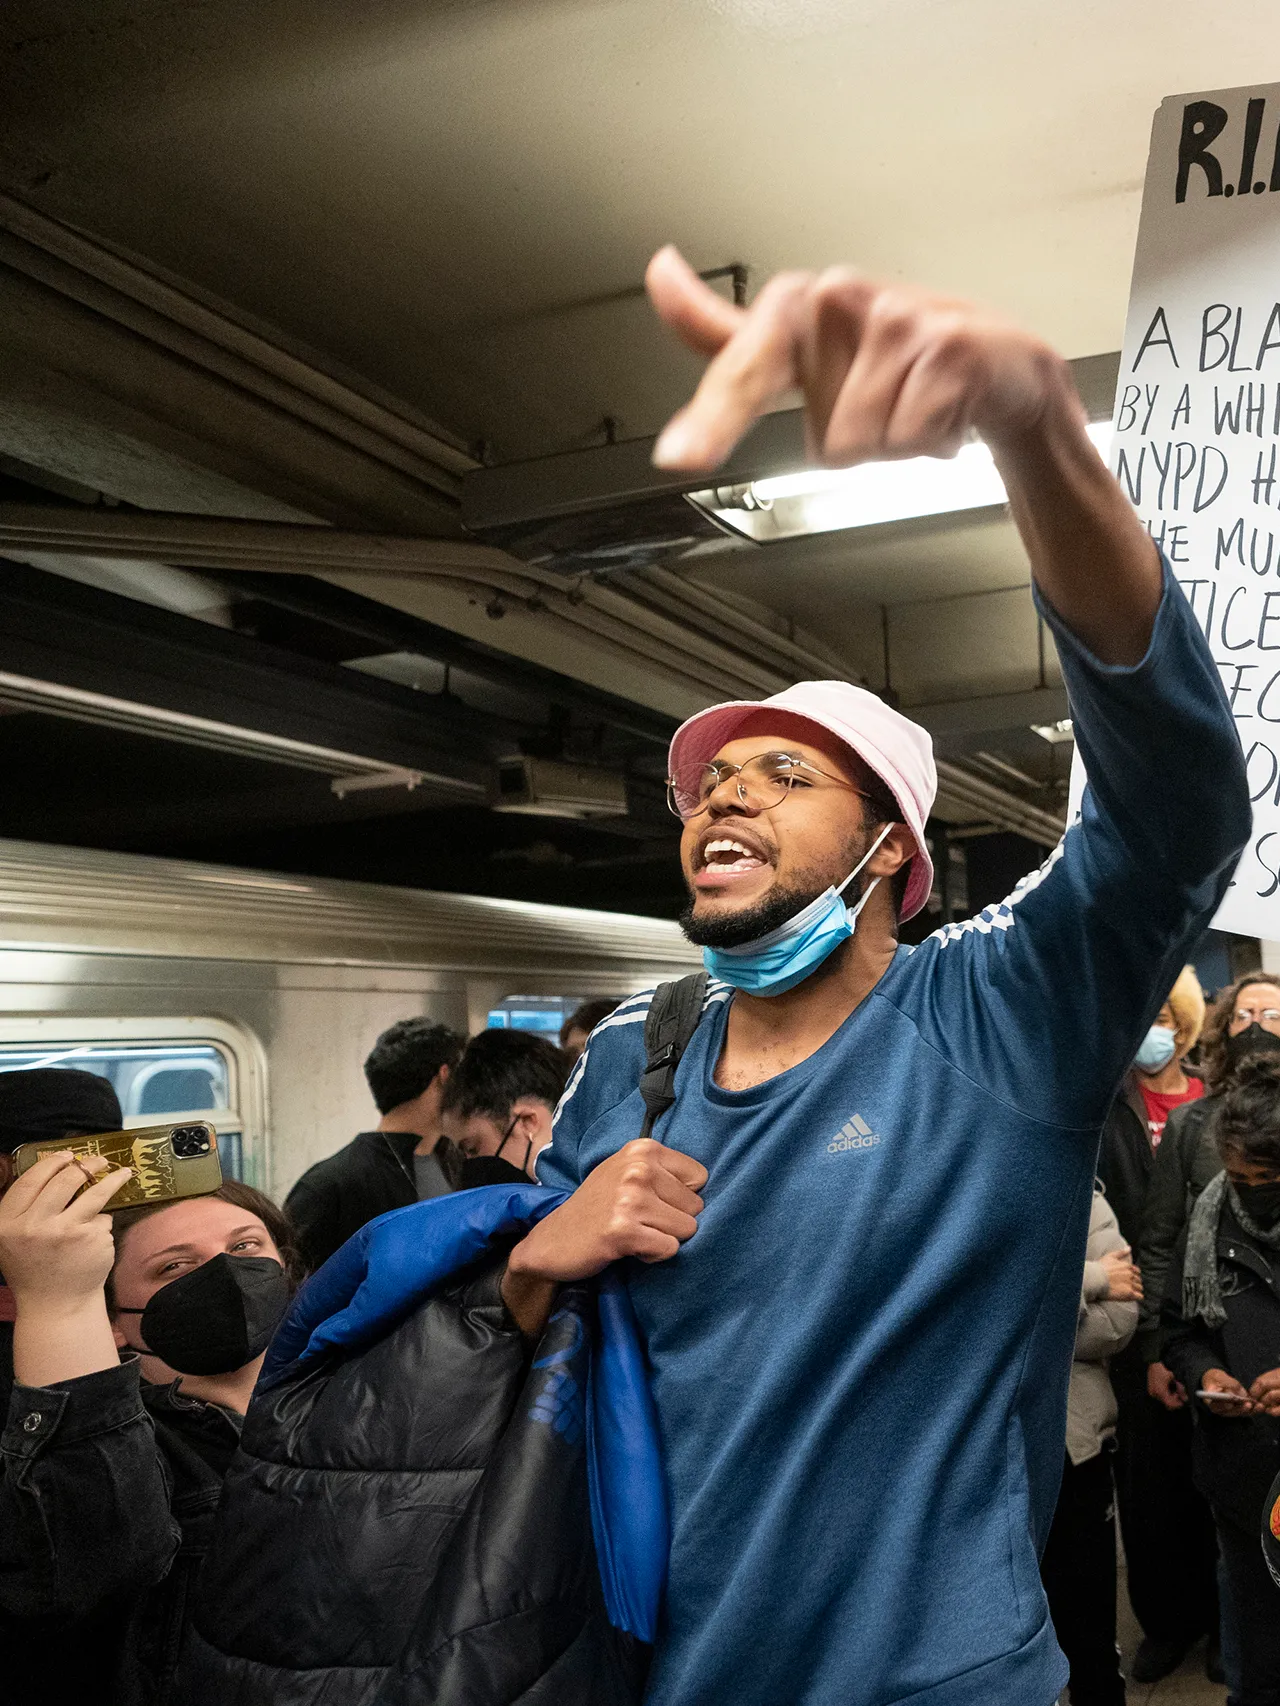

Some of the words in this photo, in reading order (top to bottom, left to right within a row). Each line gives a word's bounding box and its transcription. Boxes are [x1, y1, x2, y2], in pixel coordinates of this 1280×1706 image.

[1132, 306, 1179, 372] A
[1117, 382, 1159, 435] BY
[1171, 383, 1193, 430] A
[1117, 441, 1228, 513] NYPD
[1139, 519, 1189, 562] HE
[827, 1134, 880, 1154] adidas
